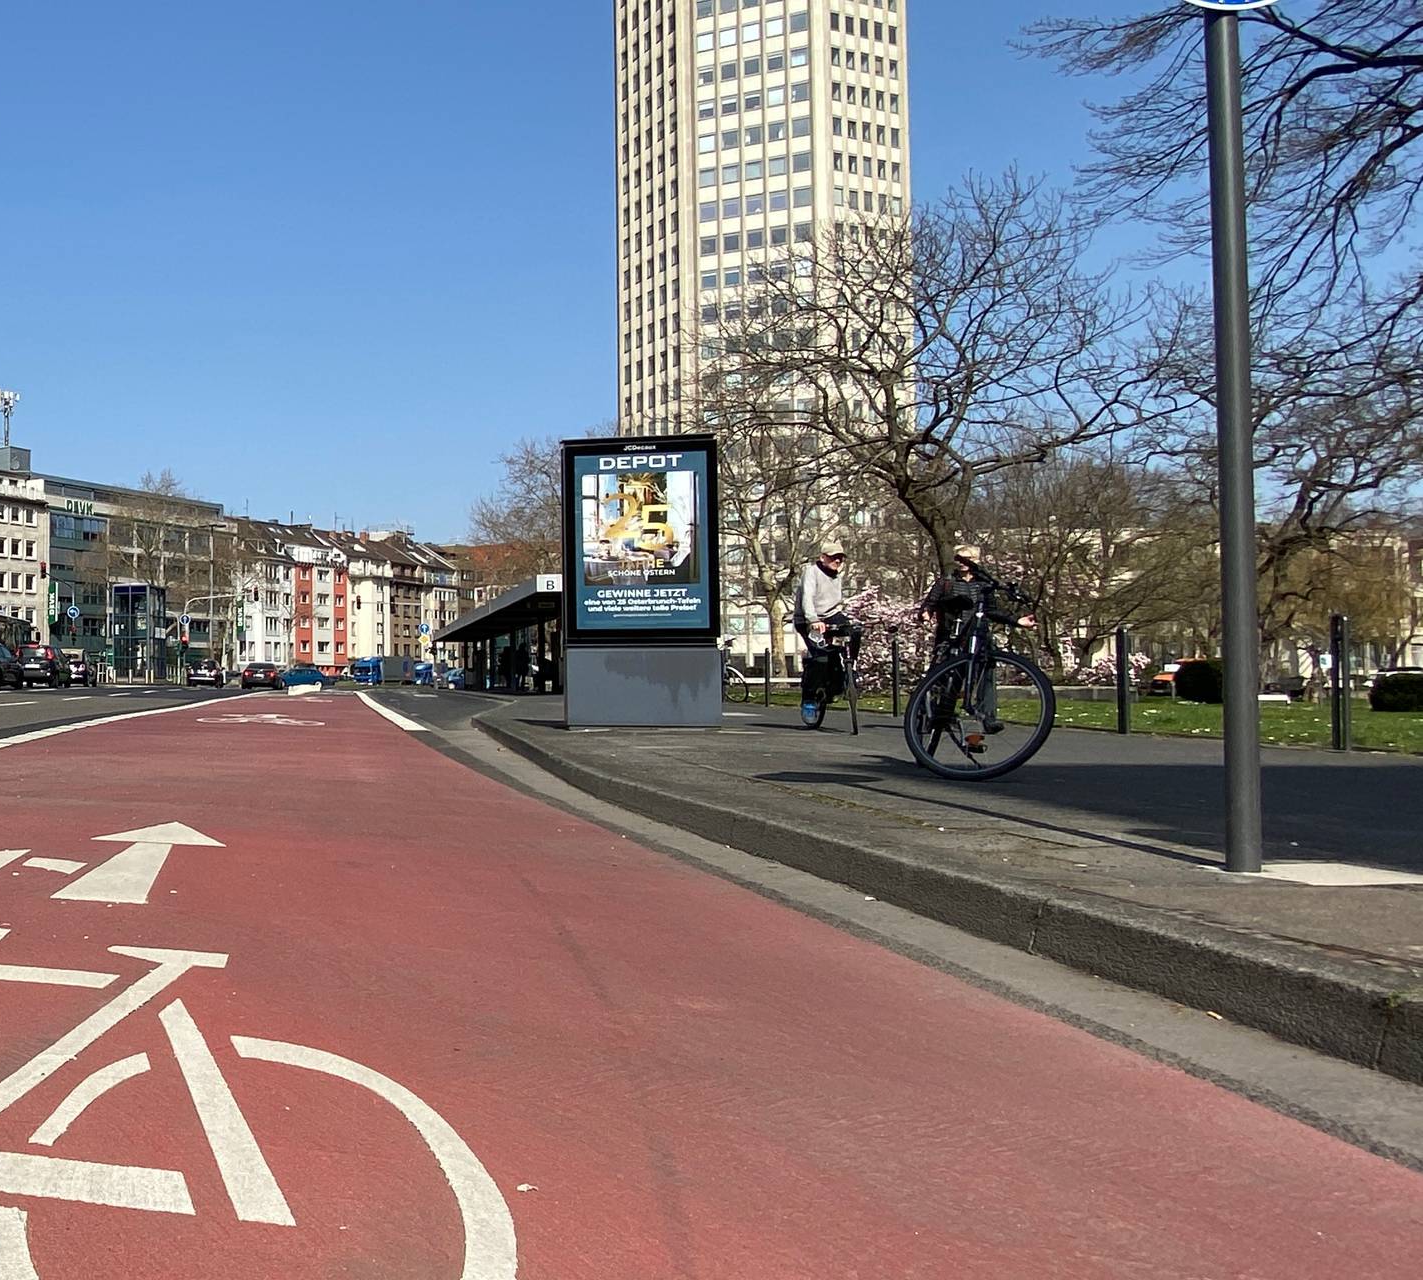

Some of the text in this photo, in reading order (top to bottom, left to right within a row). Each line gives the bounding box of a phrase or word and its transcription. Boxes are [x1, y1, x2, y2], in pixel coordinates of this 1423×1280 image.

[623, 444, 657, 452] JCDecaux
[599, 454, 683, 470] DEPOT
[607, 569, 641, 578] SCHÖNE
[546, 580, 555, 591] B
[597, 588, 688, 599] GEWINNE JETZT
